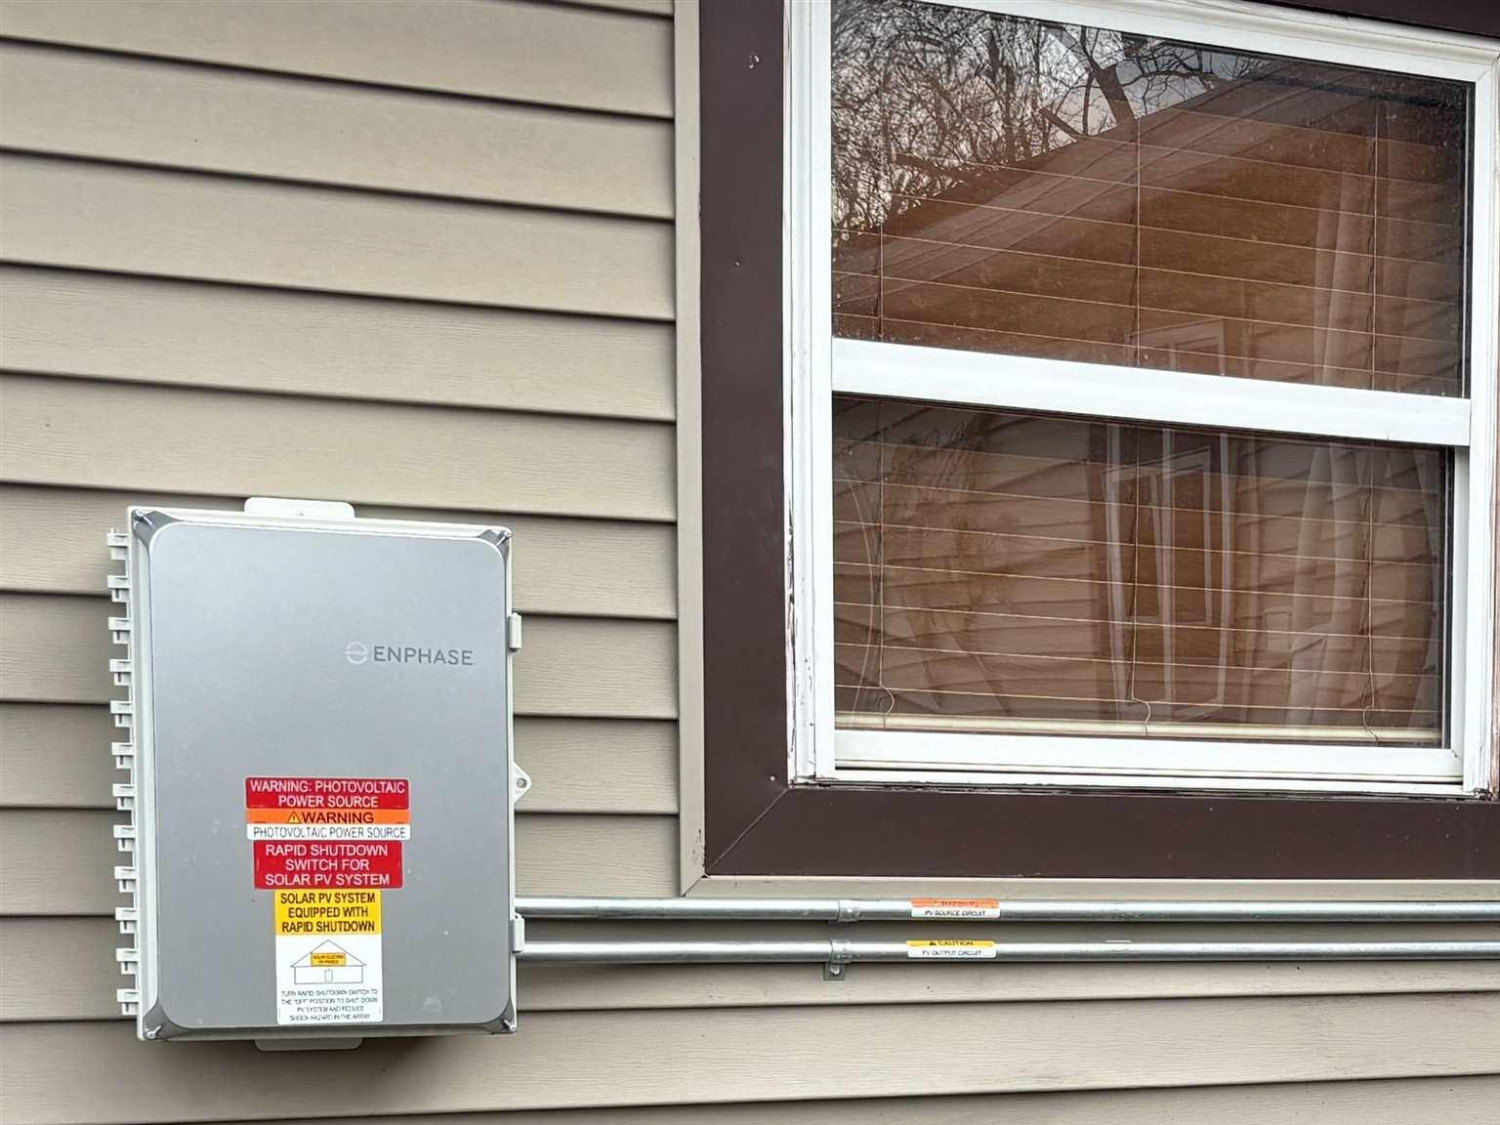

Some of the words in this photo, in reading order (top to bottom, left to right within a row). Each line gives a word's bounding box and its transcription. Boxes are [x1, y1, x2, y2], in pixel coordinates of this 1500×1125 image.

[374, 645, 474, 666] ENPHASE
[251, 780, 312, 793] WARNING:
[315, 780, 405, 794] PHOTOVOLTAIC
[278, 795, 324, 808] POWER
[328, 796, 378, 808] SOURCE
[302, 812, 374, 824] WARNING
[253, 826, 326, 838] PHOTOVOLTAIC
[329, 827, 364, 838] POWER
[367, 827, 406, 838] SOURCE
[265, 844, 307, 856] RAPID
[310, 844, 388, 856] SHUTDOWN
[285, 859, 338, 871] SWITCH
[342, 859, 370, 871] FOR
[265, 874, 310, 886] SOLAR
[314, 874, 332, 885] PV
[336, 874, 390, 886] SYSTEM
[280, 893, 316, 904] SOLAR
[318, 893, 332, 903] PV
[334, 892, 376, 904] SYSTEM
[288, 907, 341, 918] EQUIPPED
[343, 906, 368, 917] WITH
[282, 921, 313, 932] RAPID
[316, 921, 375, 932] SHUTDOWN
